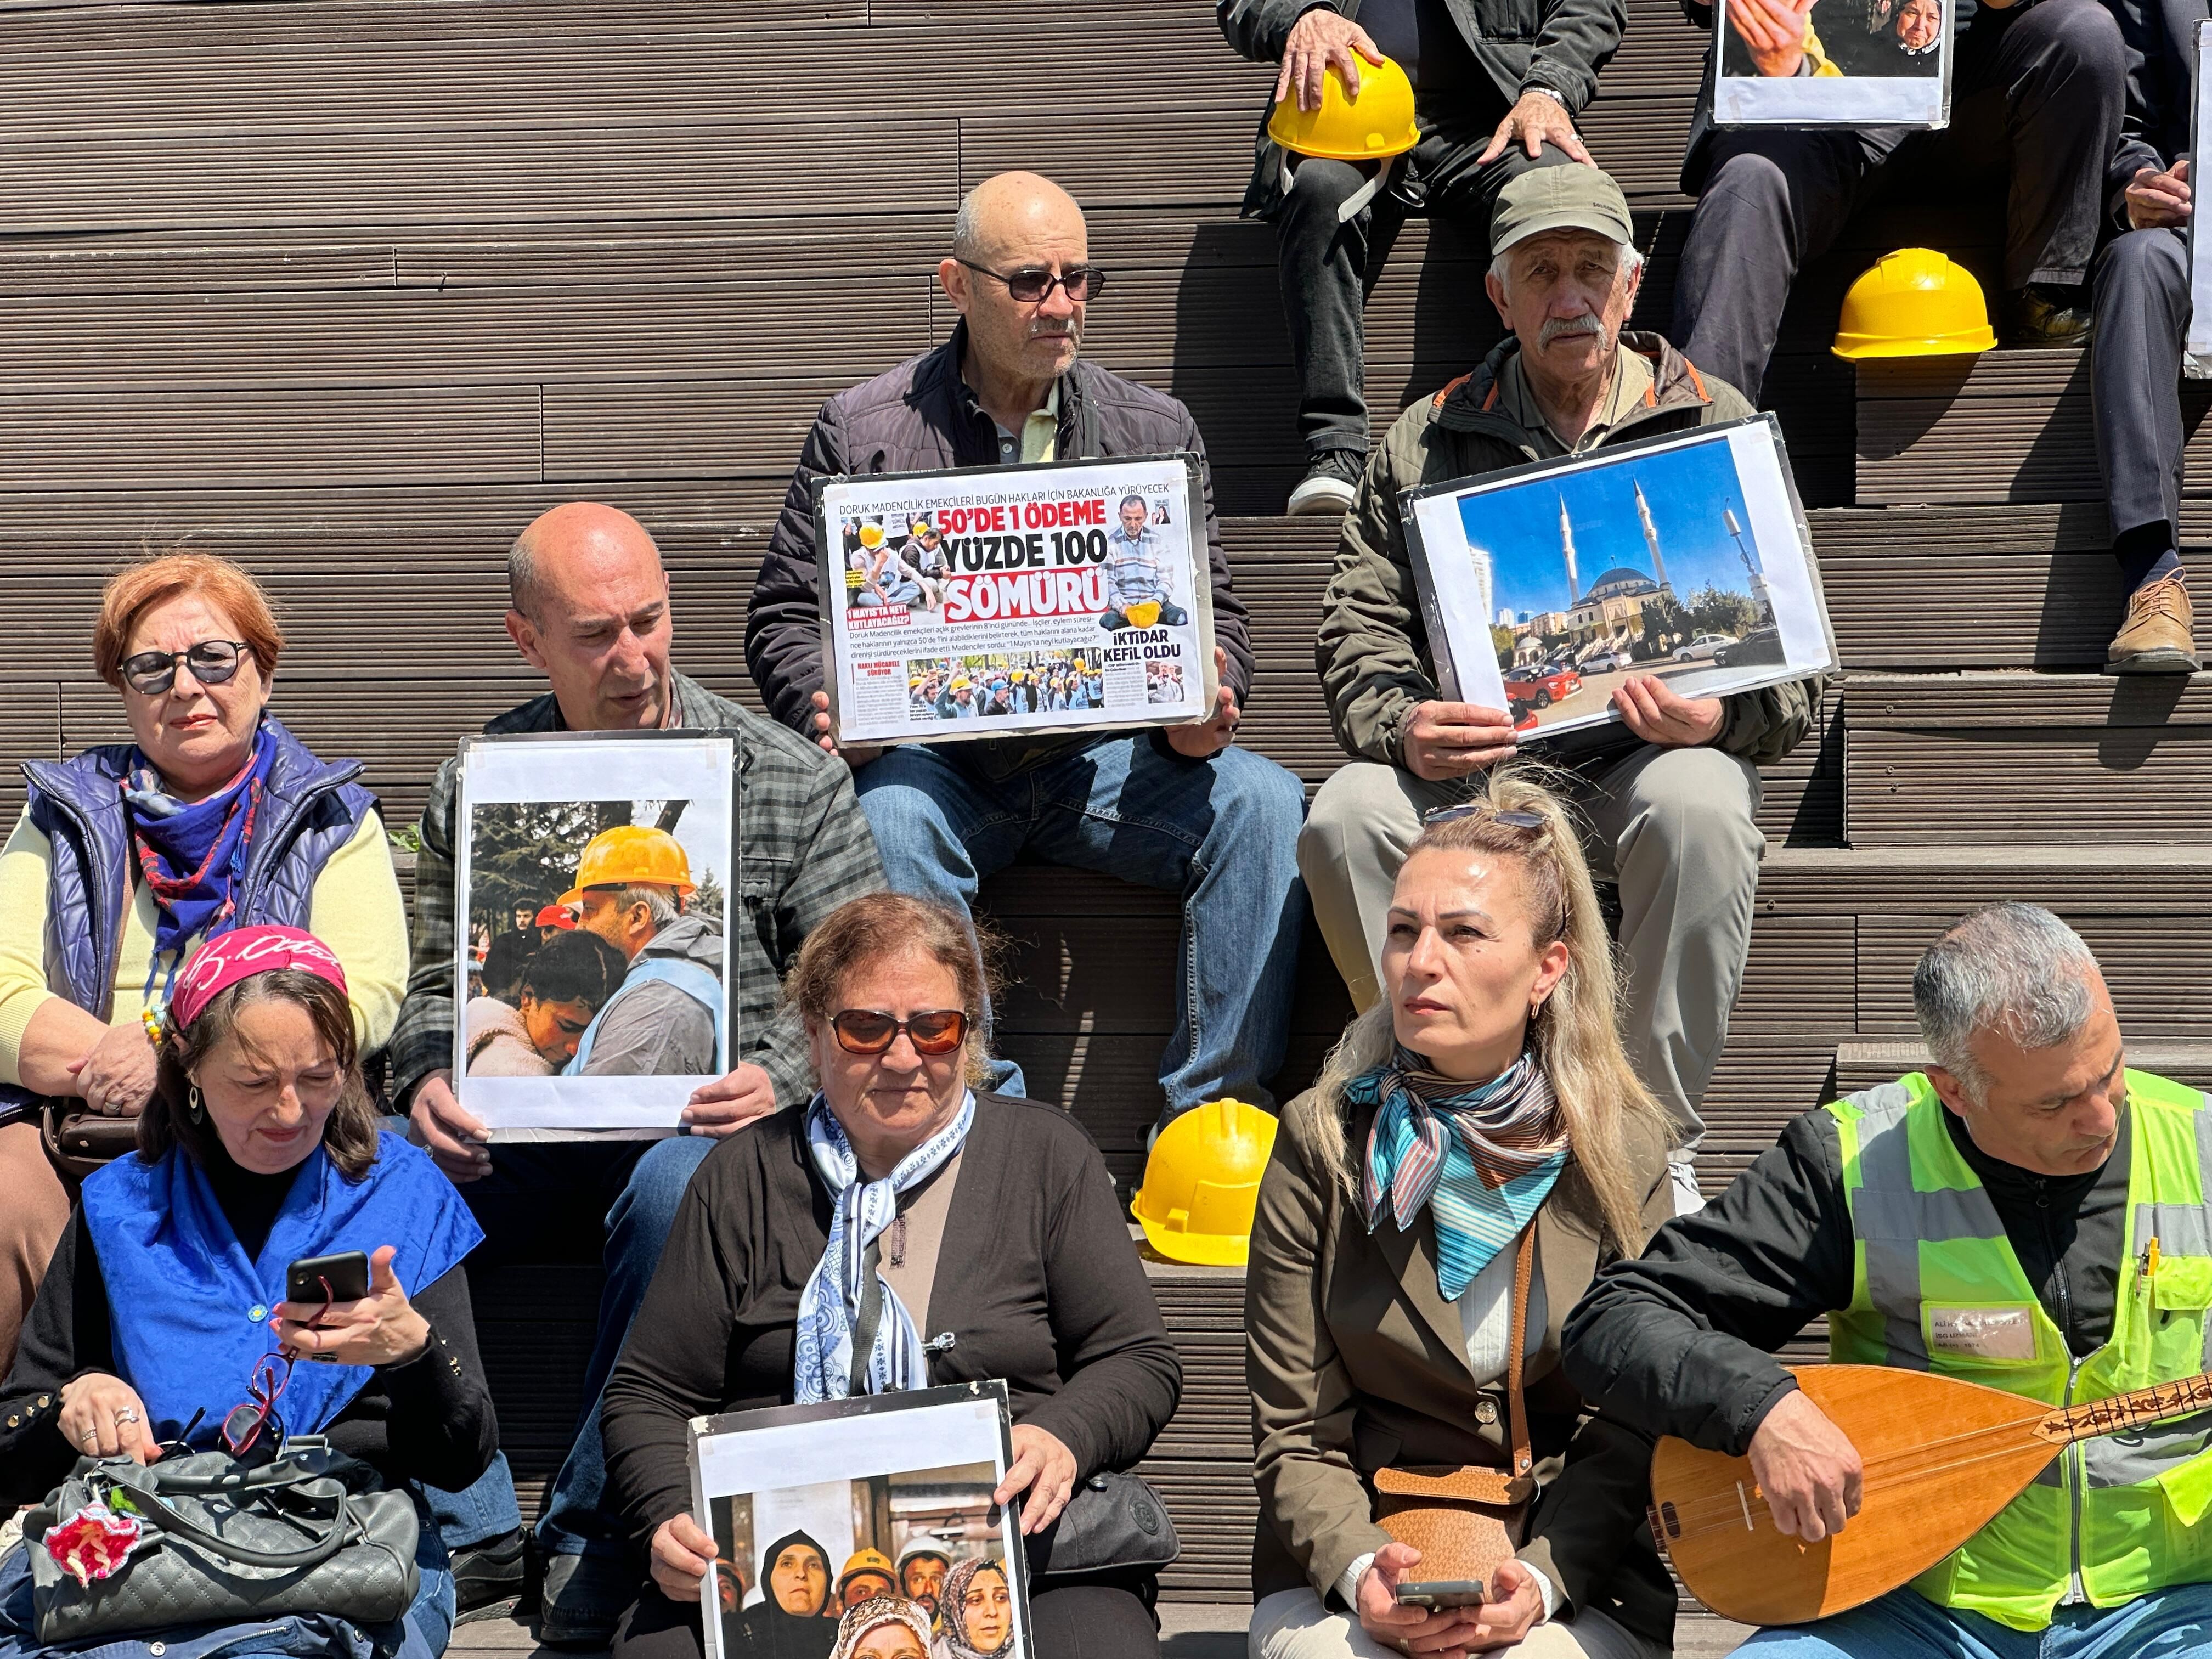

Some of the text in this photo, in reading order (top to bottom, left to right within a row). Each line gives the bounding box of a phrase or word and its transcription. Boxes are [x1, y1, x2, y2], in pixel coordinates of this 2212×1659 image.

[839, 483, 1170, 515] DORUK MADENCİLİK EMEKÇİLERİ BUGÜN HAKLARI İÇİN BAKANLIĞA YÜRÜYECEK
[938, 506, 1006, 535] 50'DE
[1009, 505, 1020, 530] 1
[1024, 499, 1107, 529] ÖDEME
[940, 529, 1108, 572] YÜZDE 100
[947, 567, 1109, 620] SÖMÜRÜ
[870, 629, 901, 637] Madencilik
[903, 627, 934, 635] emekçileri
[951, 622, 983, 633] grevlerinin
[1053, 617, 1072, 625] eylem
[862, 640, 891, 648] haklarının
[893, 638, 917, 647] yalnızca
[949, 632, 988, 642] alabildiklerini
[1034, 628, 1060, 636] haklarını
[851, 650, 872, 659] direnişi
[873, 647, 922, 657] sürdüreceklerini
[952, 643, 985, 651] Madenciler
[1040, 638, 1054, 647] neyi
[1143, 644, 1180, 659] OLDU
[867, 668, 891, 676] SÜRÜYOR
[873, 660, 900, 669] MÜCADELE
